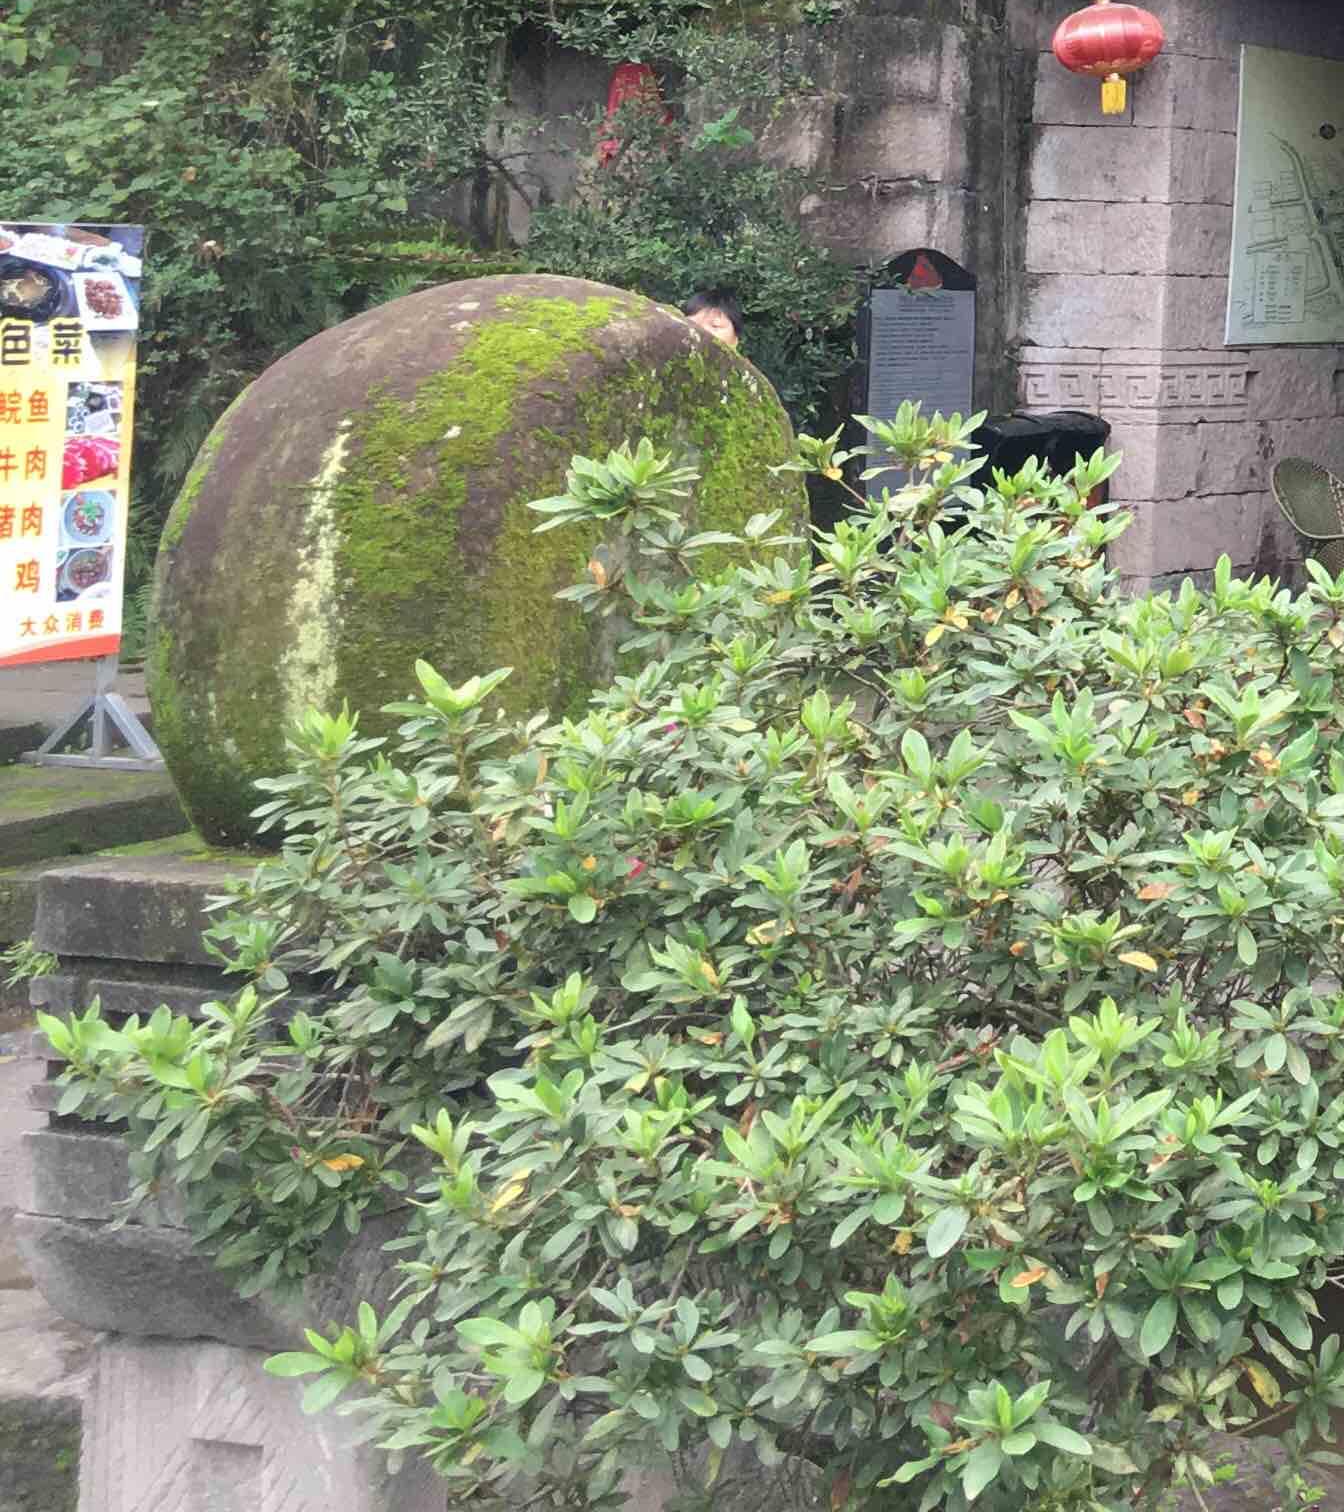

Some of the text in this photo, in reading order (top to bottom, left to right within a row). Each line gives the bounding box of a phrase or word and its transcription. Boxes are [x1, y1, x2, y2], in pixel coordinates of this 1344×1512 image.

[1, 322, 84, 366] 色菜
[15, 557, 41, 593] 鸡
[20, 609, 105, 637] 大众消费
